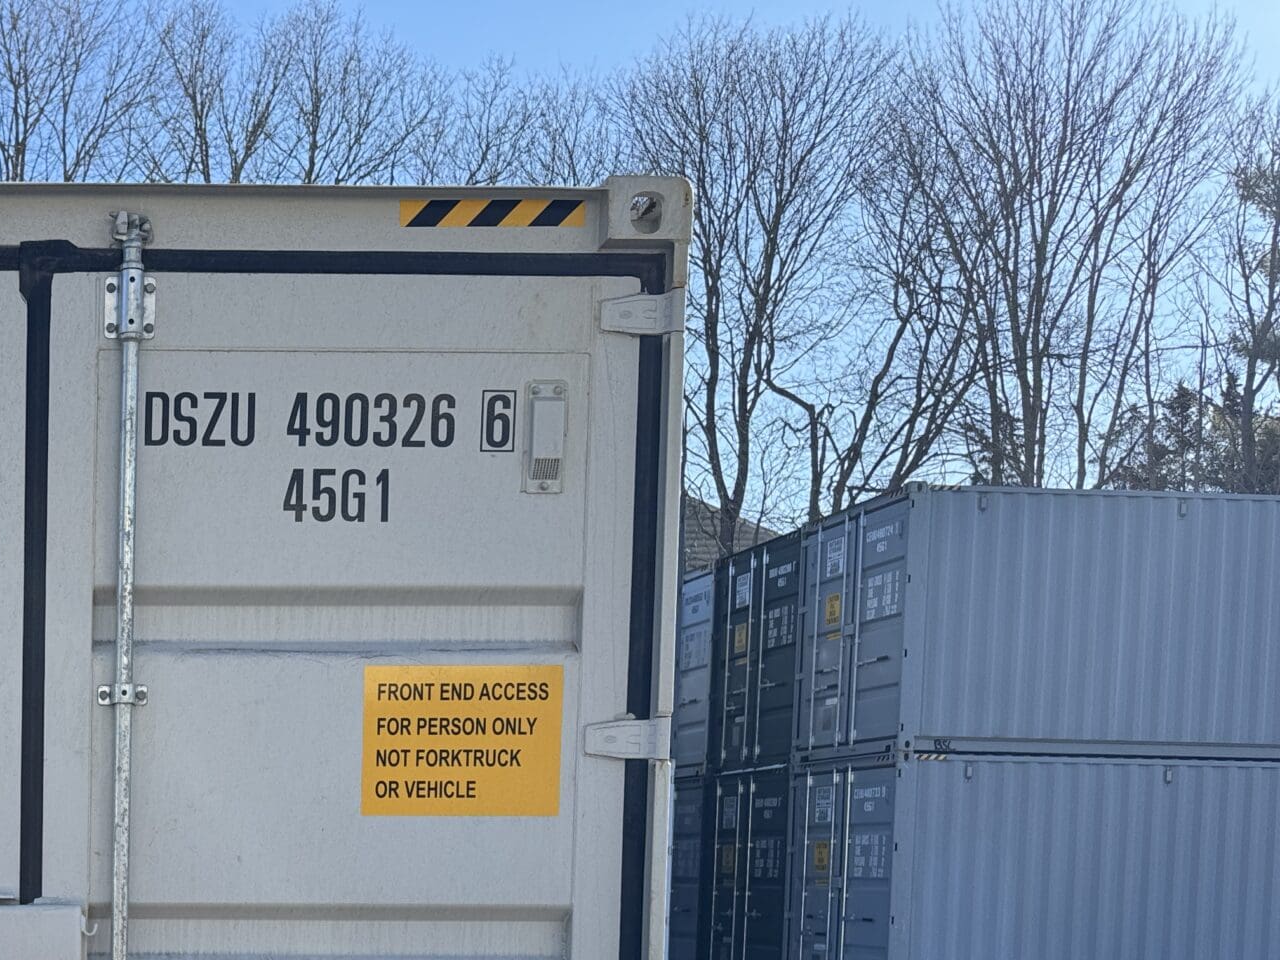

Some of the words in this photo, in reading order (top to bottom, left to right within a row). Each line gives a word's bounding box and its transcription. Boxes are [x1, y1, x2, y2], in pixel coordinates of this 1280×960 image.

[144, 391, 257, 447] DSZU
[286, 392, 457, 448] 490326
[485, 394, 511, 449] 6
[283, 468, 390, 523] 45G1
[377, 682, 435, 701] FRONT
[439, 682, 474, 701] END
[479, 682, 549, 701] ACCESS
[376, 717, 412, 736] FOR
[417, 717, 486, 736] PERSON
[492, 717, 538, 736] ONLY
[376, 749, 411, 767] NOT
[415, 749, 522, 767] FORKTRUCK
[375, 780, 399, 799] OR
[404, 780, 477, 799] VEHICLE
